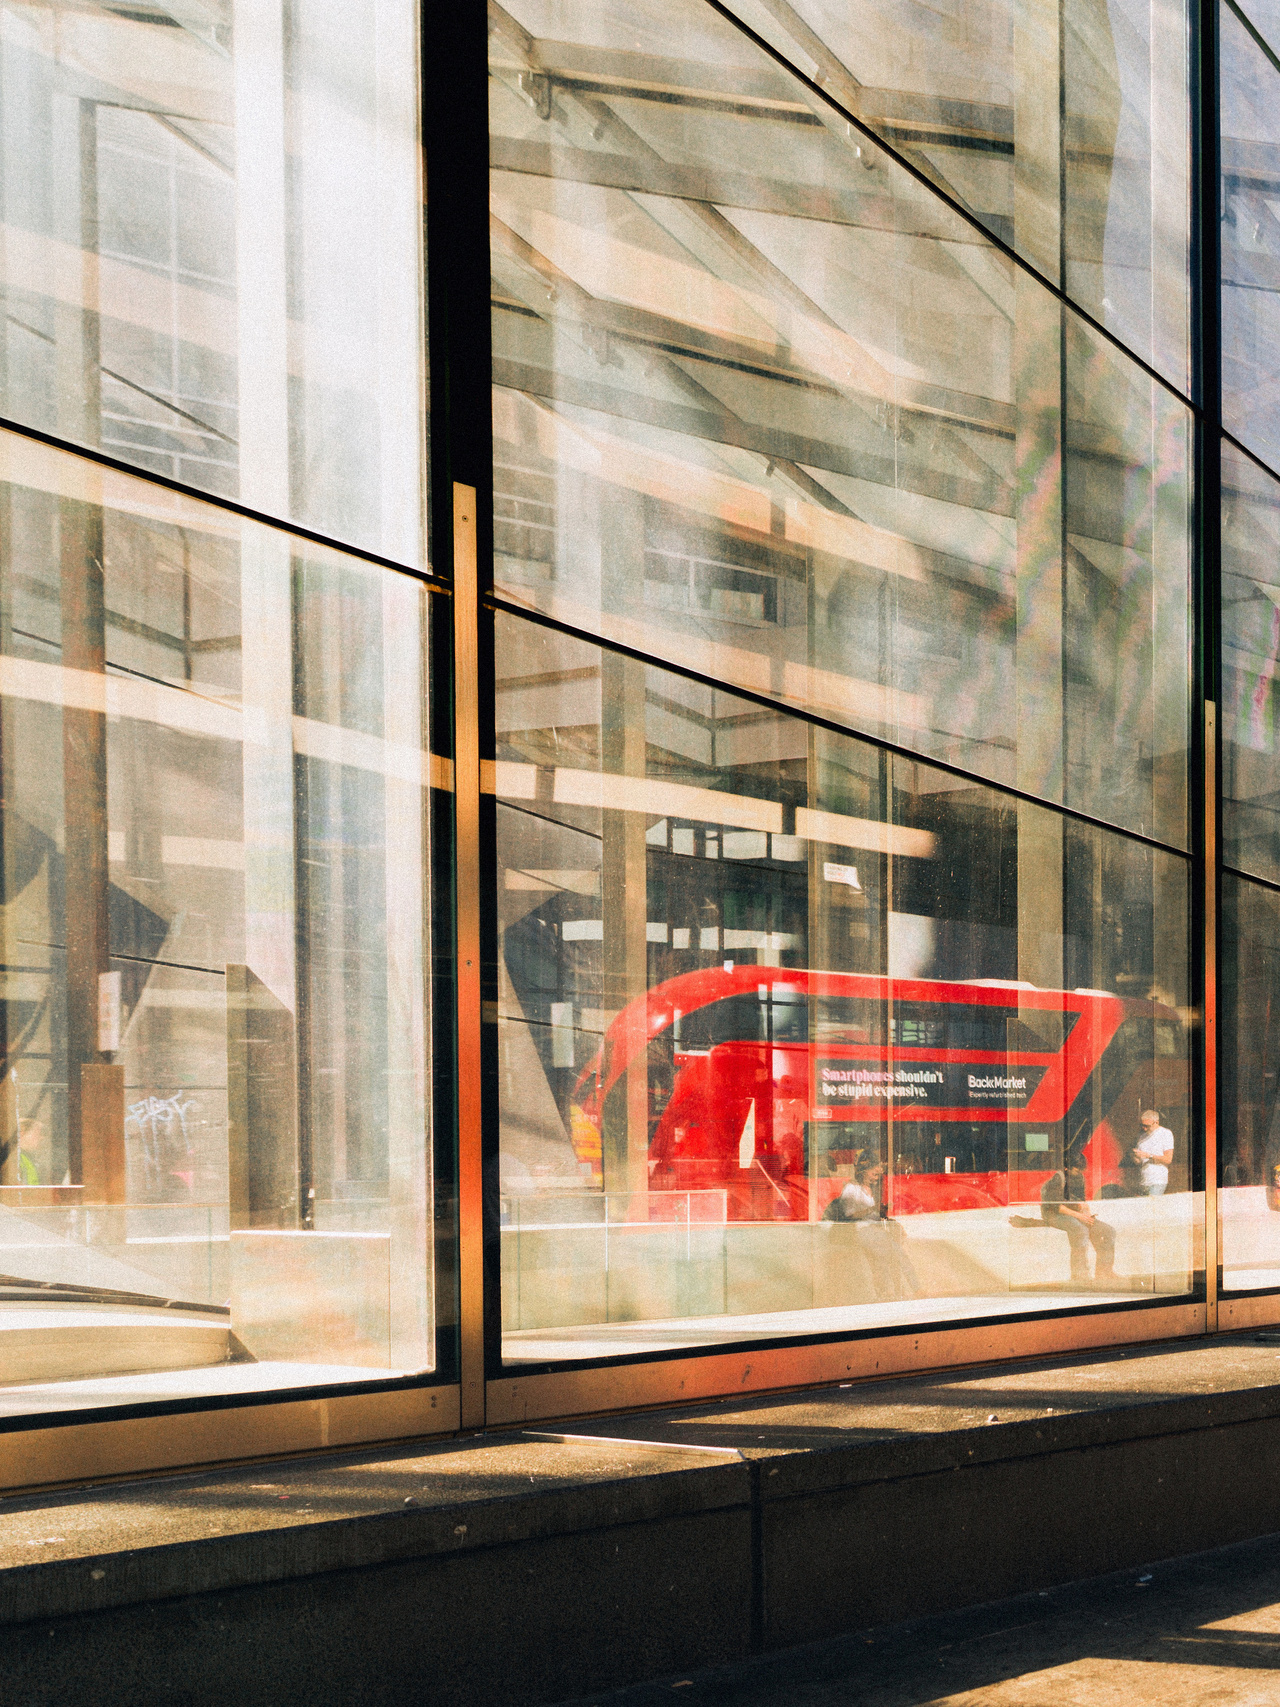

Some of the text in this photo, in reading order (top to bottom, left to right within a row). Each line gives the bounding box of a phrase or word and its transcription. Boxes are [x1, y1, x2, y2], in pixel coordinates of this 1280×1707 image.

[821, 1068, 944, 1084] Smartphones shouldn't
[822, 1082, 928, 1099] be stupid expensive.
